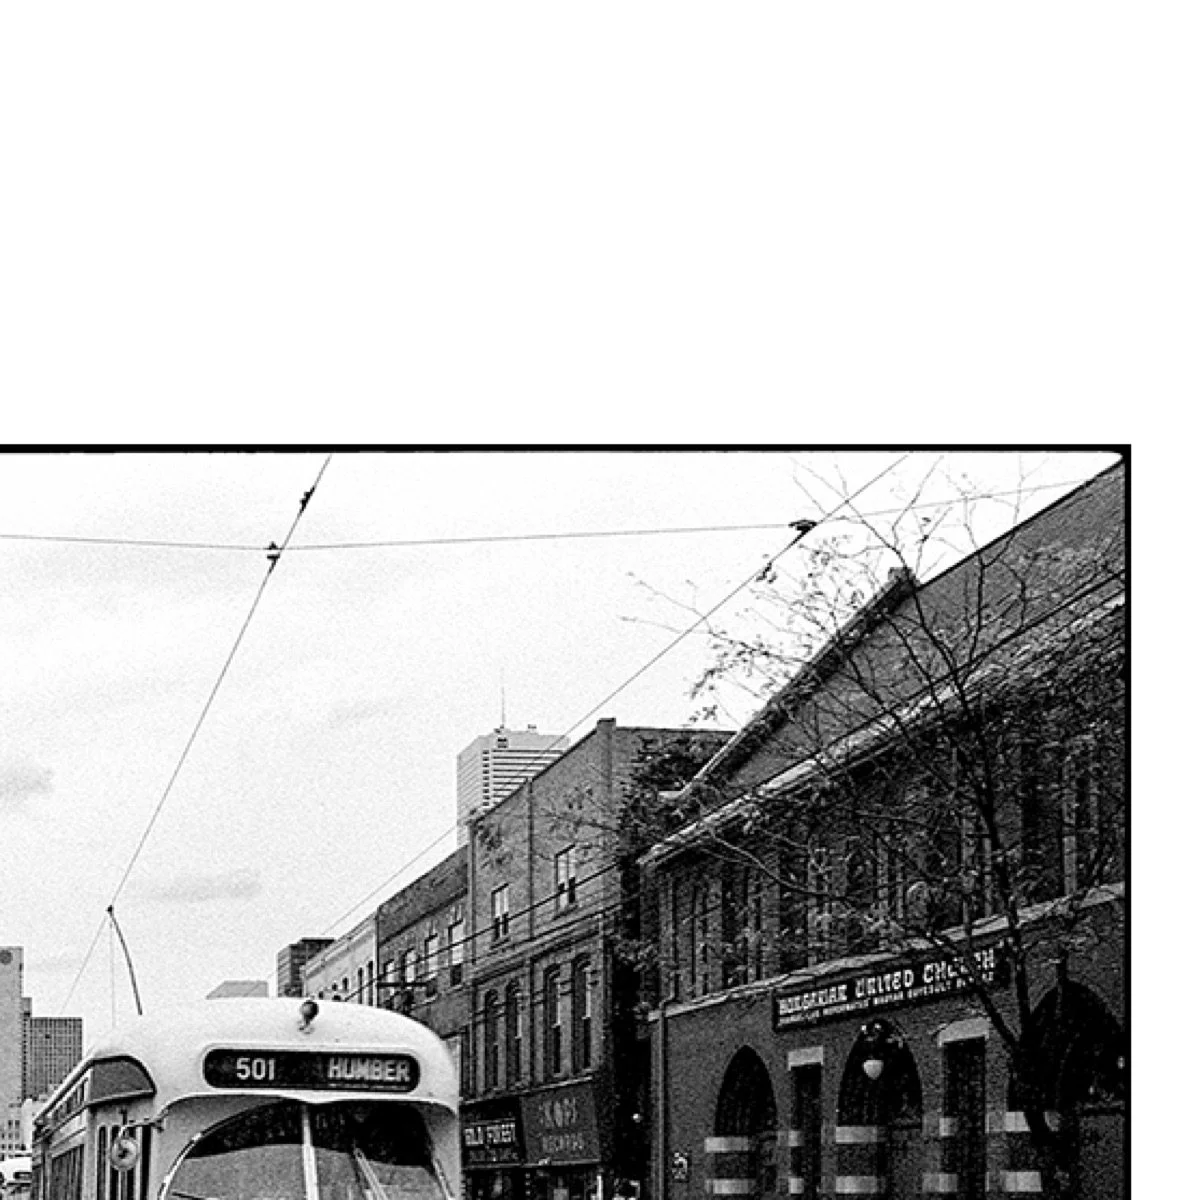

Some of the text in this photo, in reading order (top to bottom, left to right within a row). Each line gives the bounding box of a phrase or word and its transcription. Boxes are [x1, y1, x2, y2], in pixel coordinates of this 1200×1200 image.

[855, 969, 915, 998] UNITED
[236, 1057, 411, 1082] 501 HUMBER
